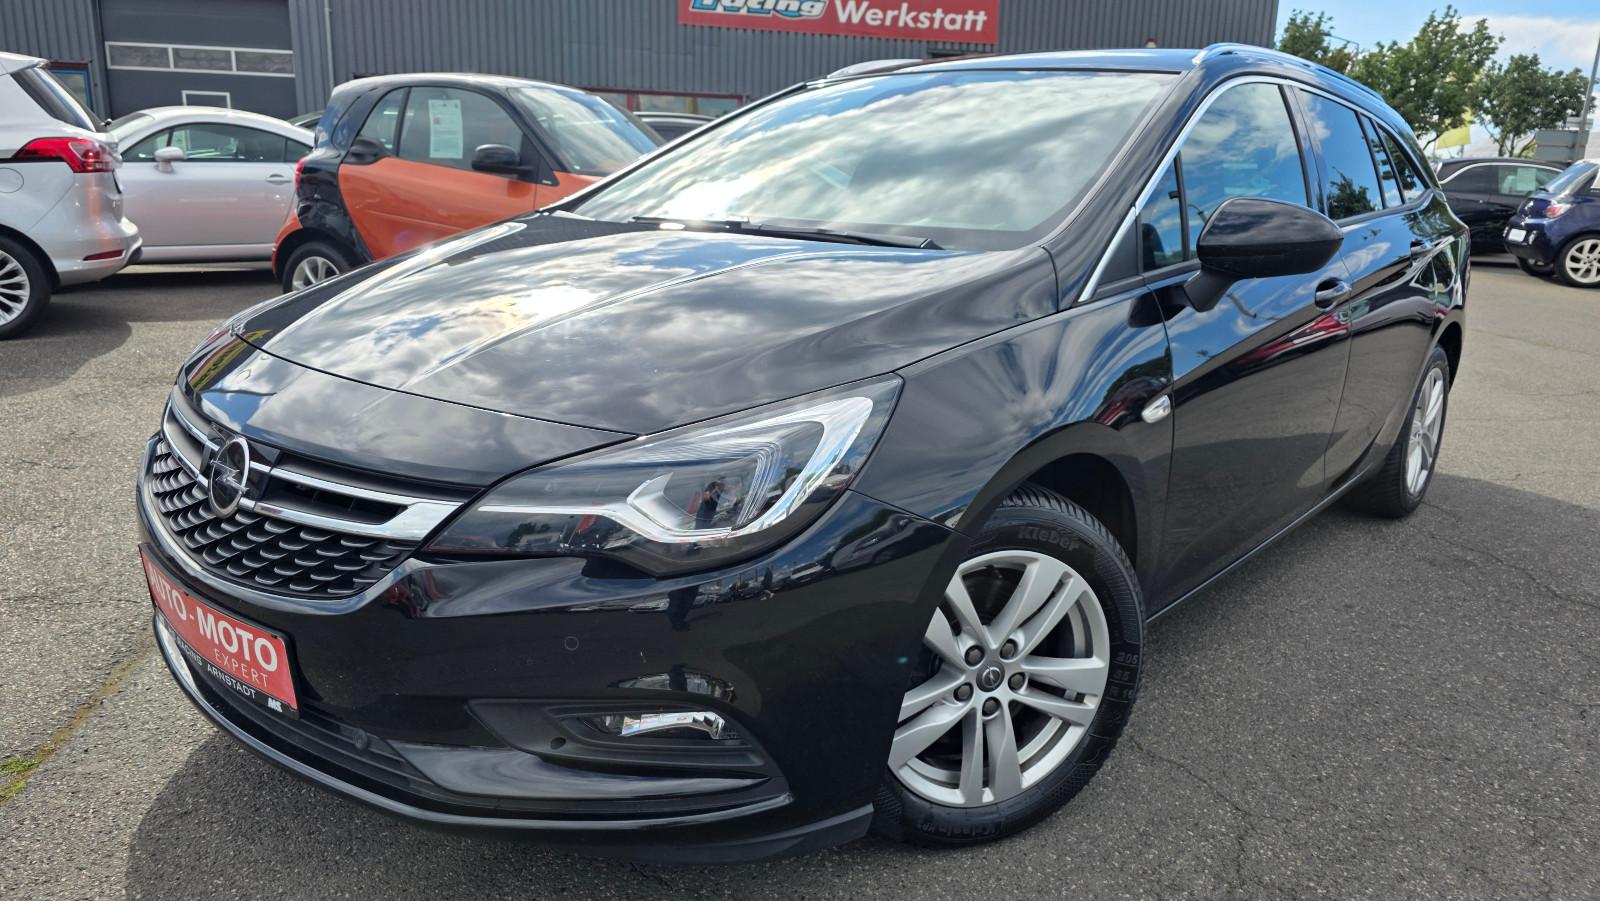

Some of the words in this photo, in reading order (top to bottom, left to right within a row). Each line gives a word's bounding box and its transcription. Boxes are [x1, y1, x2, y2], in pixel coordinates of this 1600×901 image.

[834, 1, 988, 32] Werkstatt
[1016, 526, 1080, 551] Kleber
[207, 664, 256, 699] ARNSTADT
[214, 649, 269, 688] EXPERT
